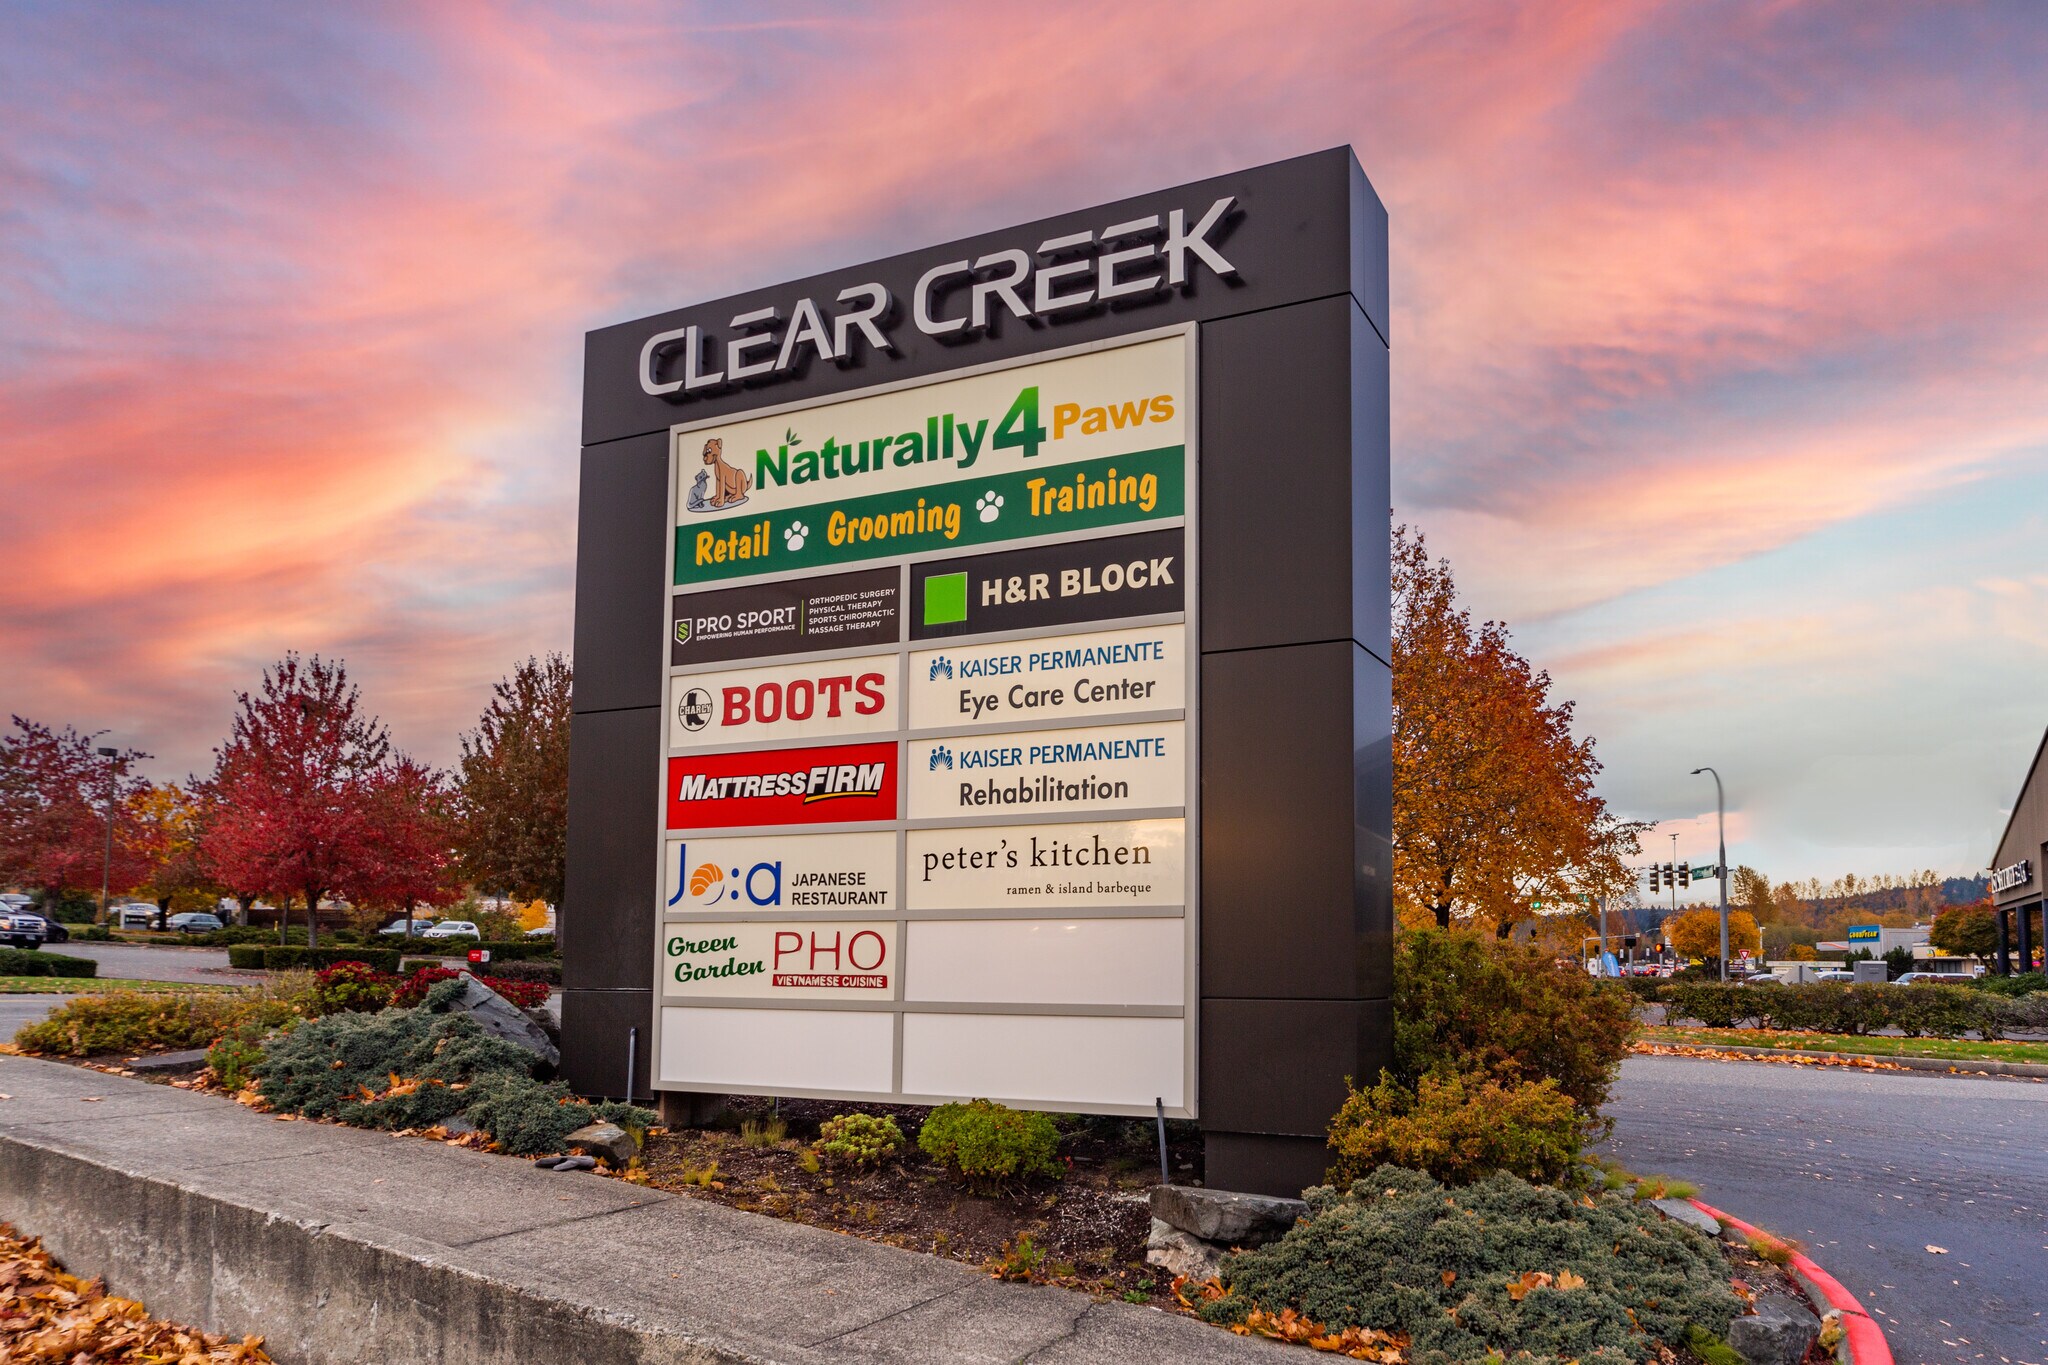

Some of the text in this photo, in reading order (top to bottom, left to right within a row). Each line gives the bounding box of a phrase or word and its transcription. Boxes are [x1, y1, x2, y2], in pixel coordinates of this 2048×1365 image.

[639, 196, 1238, 396] CLEAR CREEK
[1053, 393, 1175, 440] Paws
[695, 468, 1158, 567] Retail Grooming Training
[981, 556, 1174, 607] H&R BLOCK
[809, 588, 895, 605] ORTHOPEDIC SURGERY
[809, 600, 882, 615] PHYSICAL THERAPY
[696, 606, 796, 634] PRO SPORT
[808, 620, 881, 635] MASSAGE THERAPY
[809, 608, 895, 625] SPORTS CHIROPRACTIC
[696, 624, 795, 642] EMPOWERING HUMAN PERFORMANCE
[960, 641, 1164, 678] KAISER PERMANENTE
[679, 703, 712, 716] CHARLY
[721, 672, 885, 726] BOOTS
[960, 678, 1155, 719] Eye Care Center
[960, 737, 1165, 769] KAISER PERMANENTE
[960, 774, 1128, 806] Rehabilitation
[923, 834, 1151, 882] peter's kitchen
[791, 872, 866, 887] JAPANESE
[1007, 881, 1151, 896] ramen & island barbeque
[791, 891, 888, 906] RESTAURANT
[667, 936, 739, 957] Green
[773, 930, 886, 971] PHO
[674, 957, 766, 983] Garden
[776, 975, 884, 988] VIETNAMESE CUISINE
